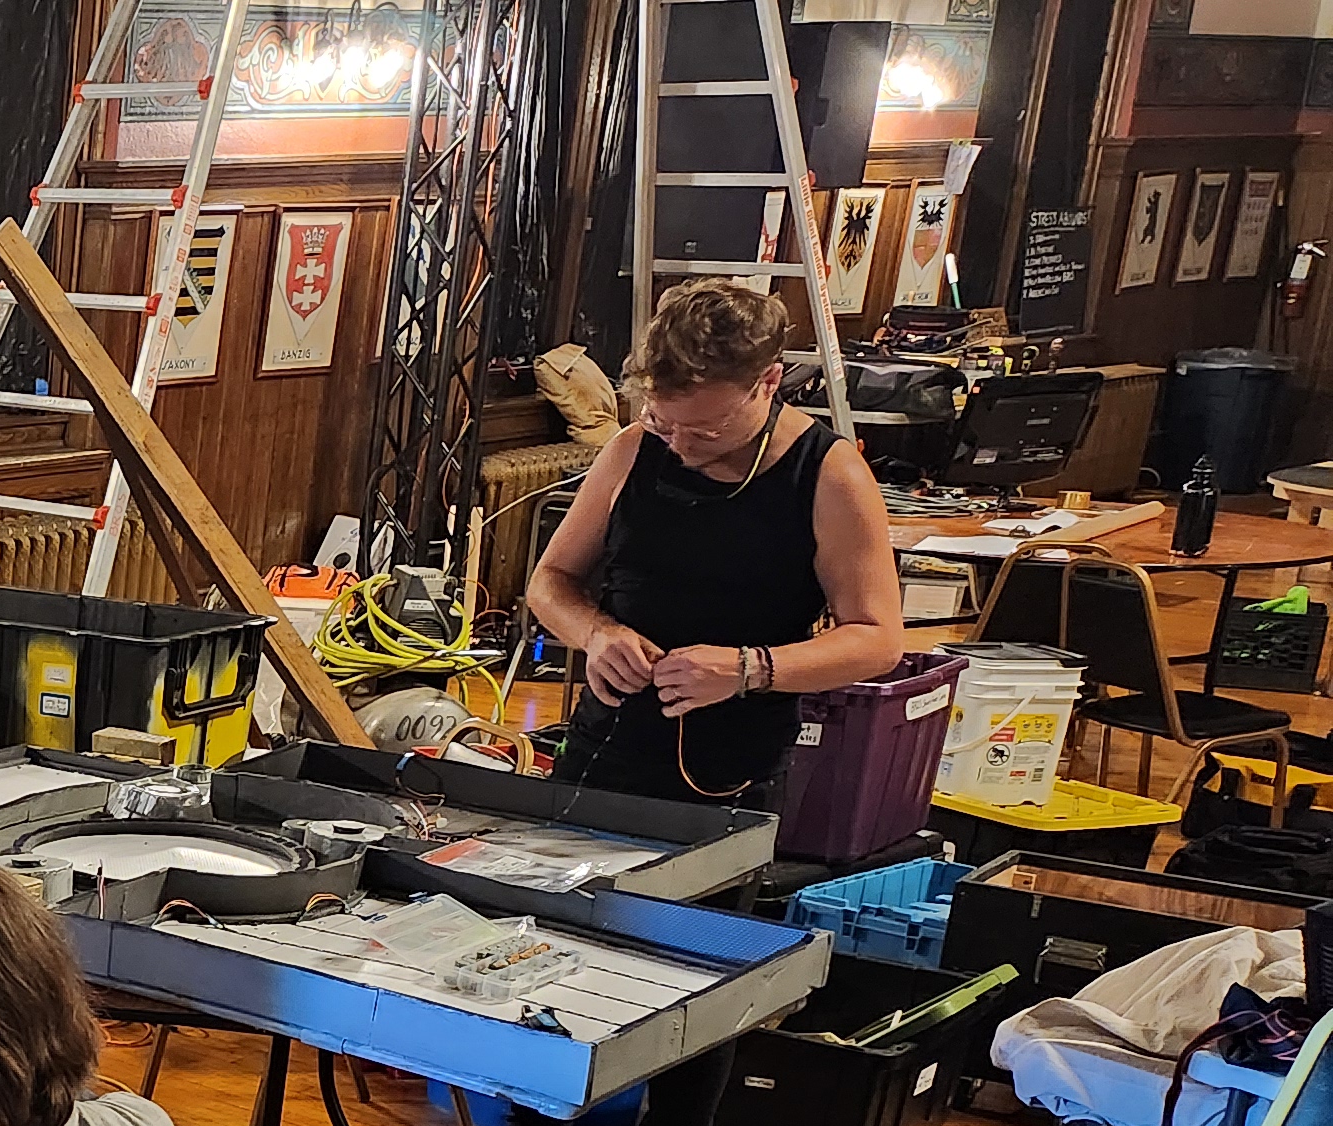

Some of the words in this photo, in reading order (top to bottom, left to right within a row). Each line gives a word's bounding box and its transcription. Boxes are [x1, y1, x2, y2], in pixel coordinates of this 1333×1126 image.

[811, 241, 825, 282] Ladder
[280, 349, 311, 360] DANZIG
[162, 359, 196, 370] SAXONY
[395, 714, 458, 741] 0092
